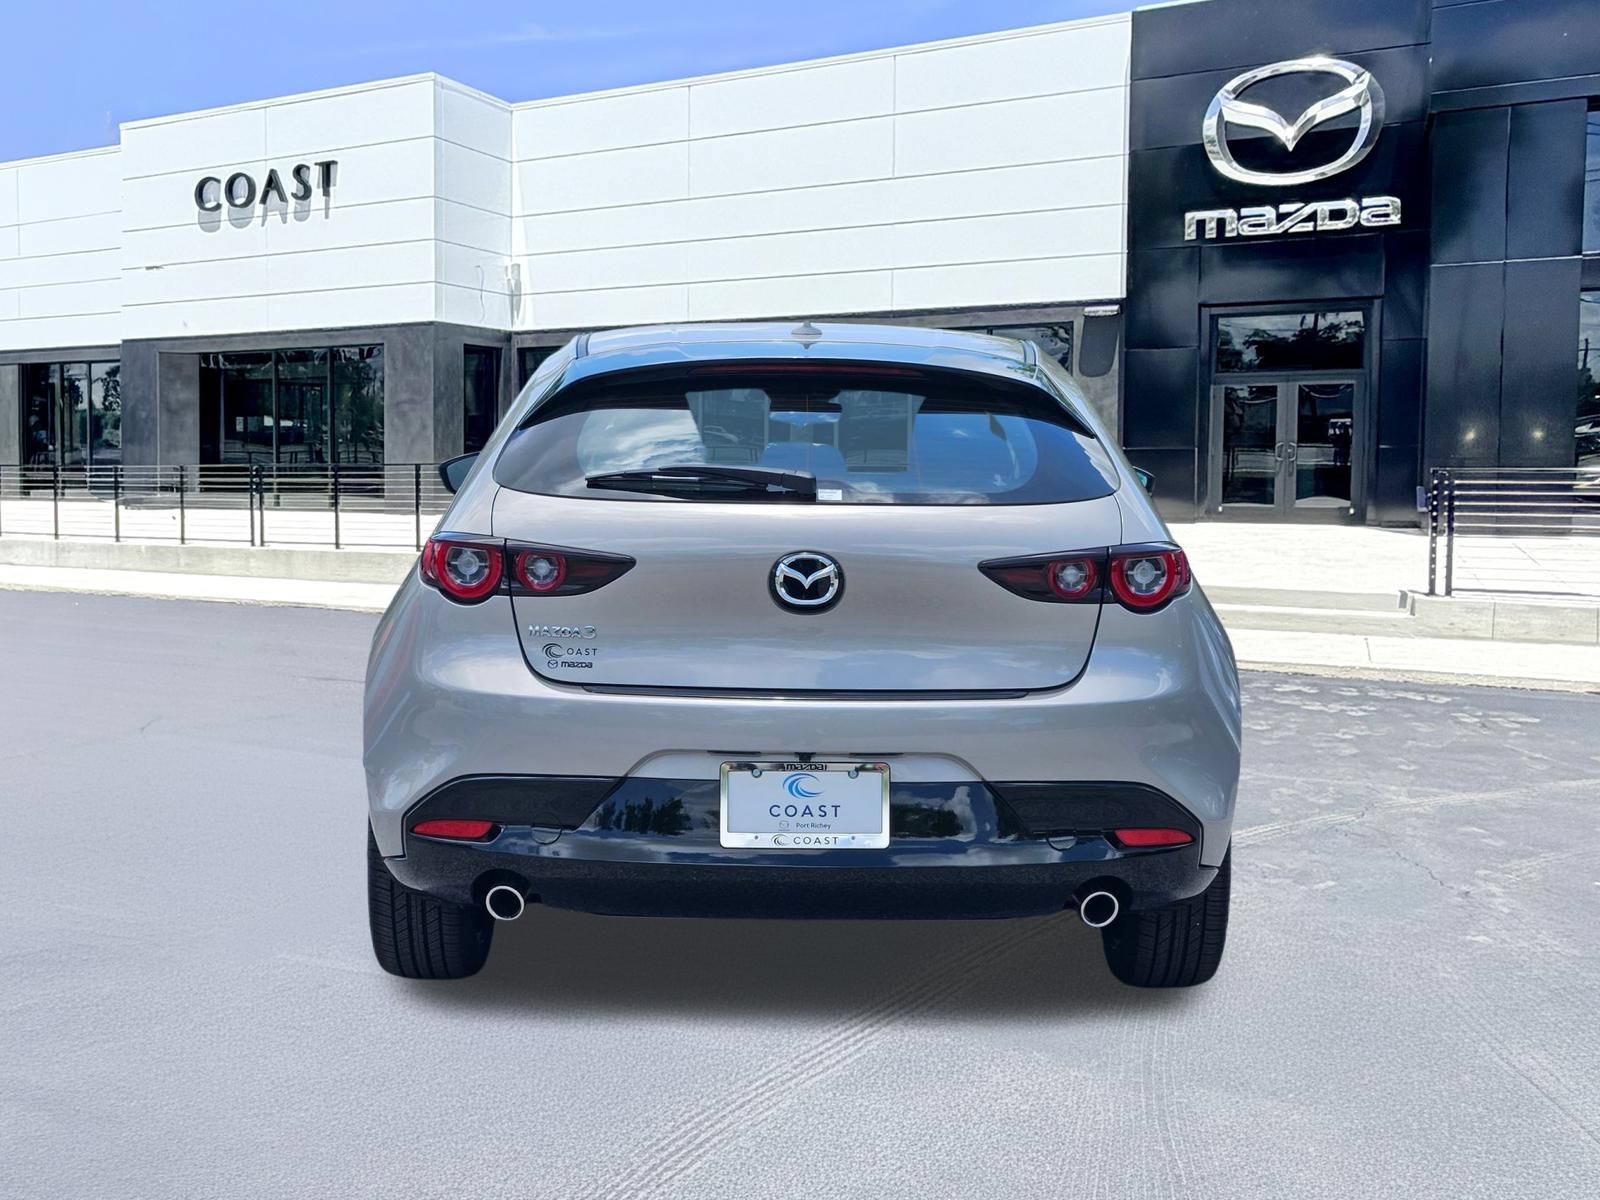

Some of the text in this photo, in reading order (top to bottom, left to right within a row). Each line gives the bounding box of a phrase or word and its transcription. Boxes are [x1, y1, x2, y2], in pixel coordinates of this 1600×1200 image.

[194, 160, 338, 212] COAST
[769, 805, 841, 817] COAST
[811, 822, 831, 830] Richey
[793, 836, 839, 845] COAST
